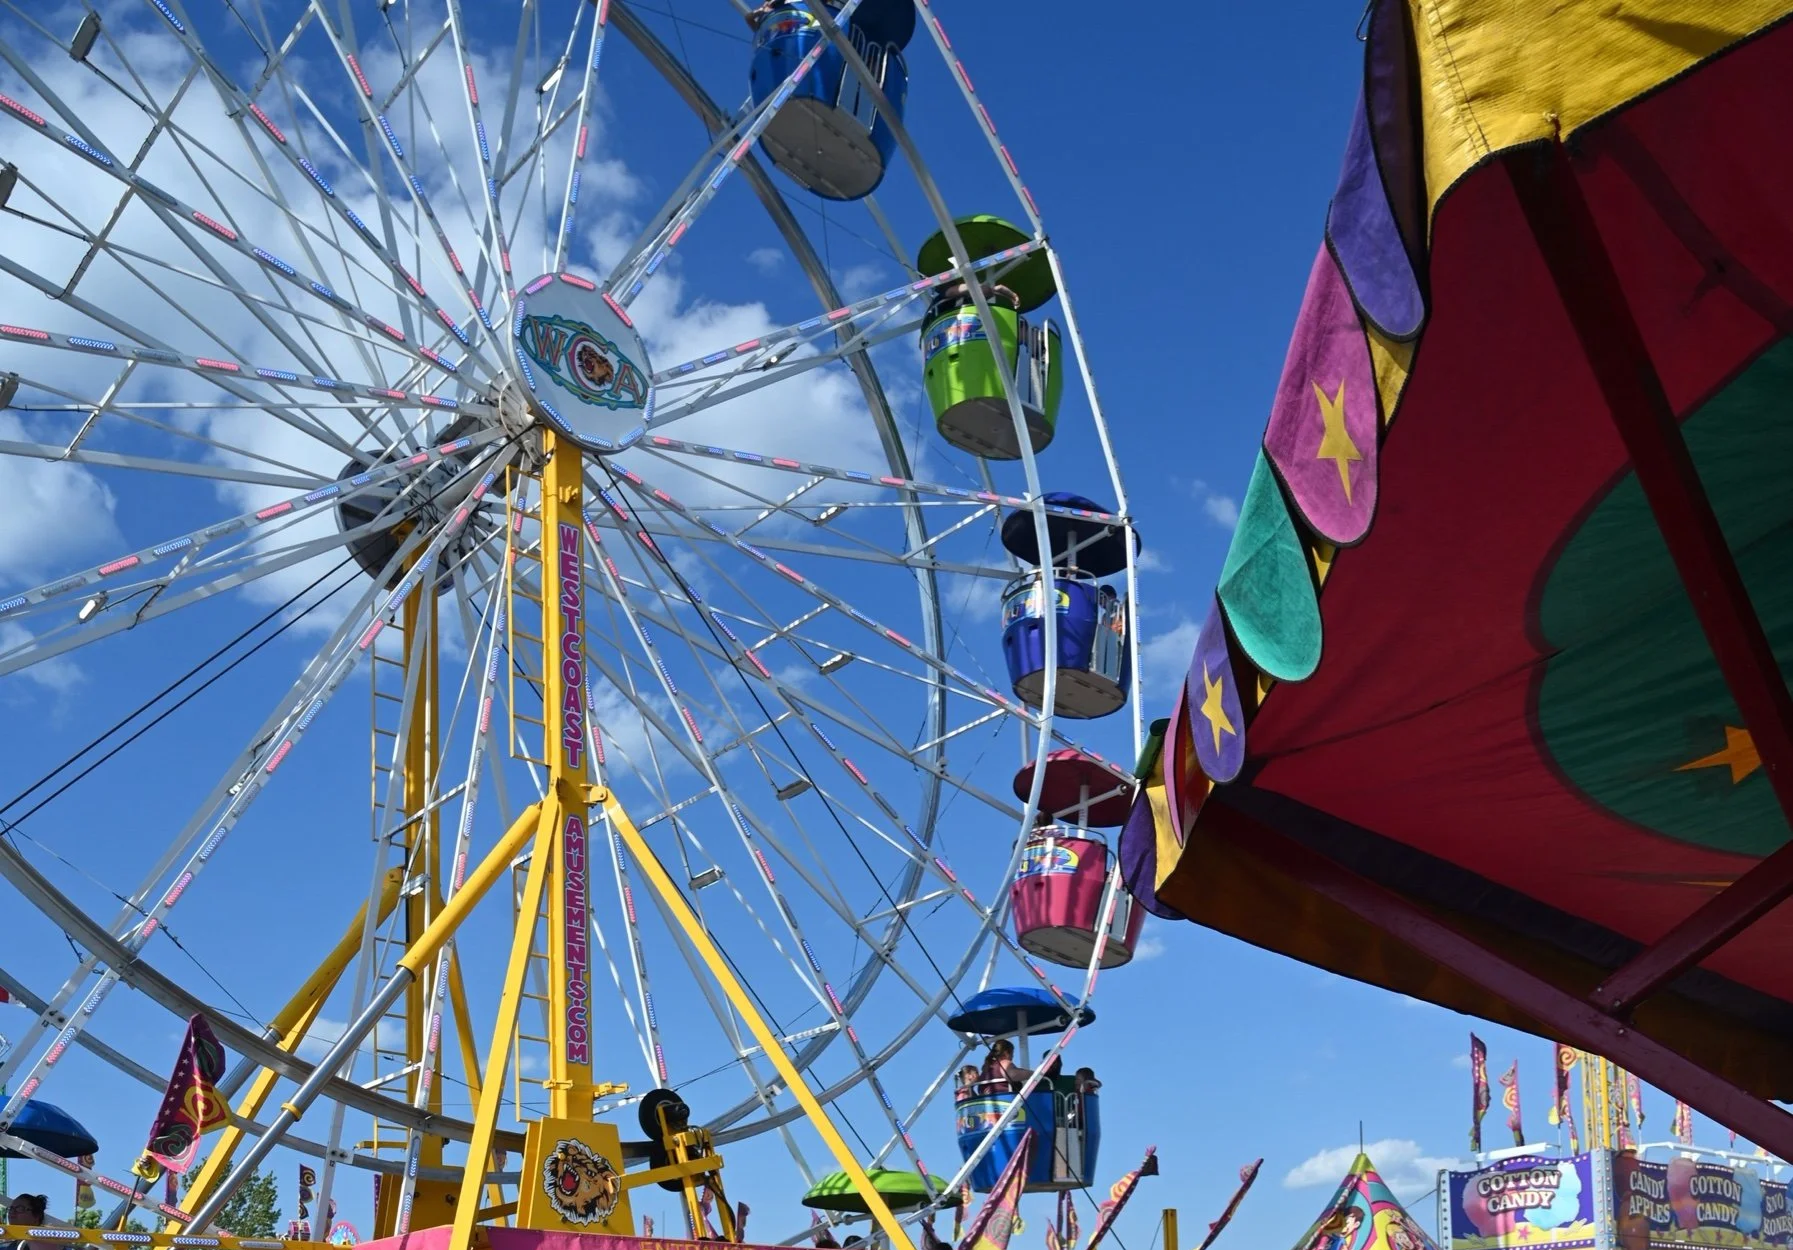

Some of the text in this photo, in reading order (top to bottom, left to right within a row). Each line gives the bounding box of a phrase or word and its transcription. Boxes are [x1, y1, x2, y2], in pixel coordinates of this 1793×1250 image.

[529, 317, 645, 406] WCA
[1478, 1169, 1561, 1195] COTTON
[1630, 1171, 1665, 1199] CANDY
[1690, 1176, 1741, 1202] COTTON
[1488, 1191, 1554, 1213] CANDY
[1629, 1195, 1670, 1223] APPLES
[1697, 1203, 1739, 1226] CANDY
[1766, 1194, 1784, 1213] SNO
